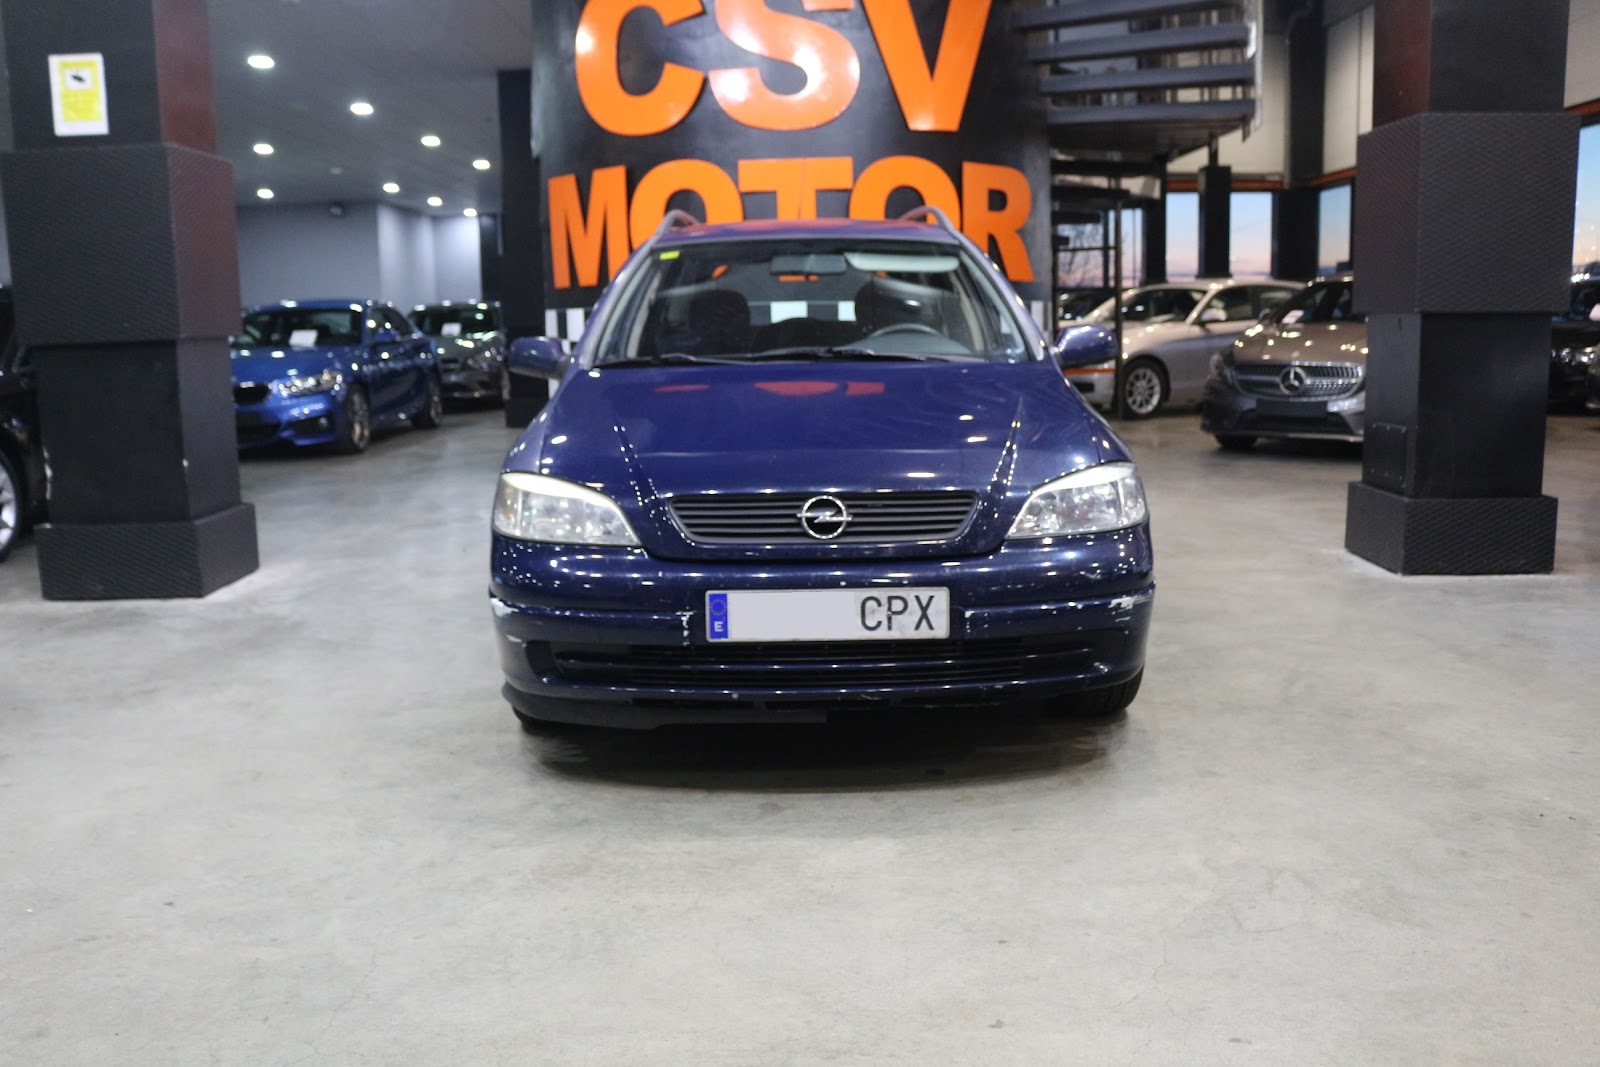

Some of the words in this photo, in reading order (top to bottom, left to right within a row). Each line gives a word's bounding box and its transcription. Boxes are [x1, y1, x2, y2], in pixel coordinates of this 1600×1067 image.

[576, 0, 992, 135] CSV
[714, 621, 723, 632] E
[860, 595, 935, 631] CPX
